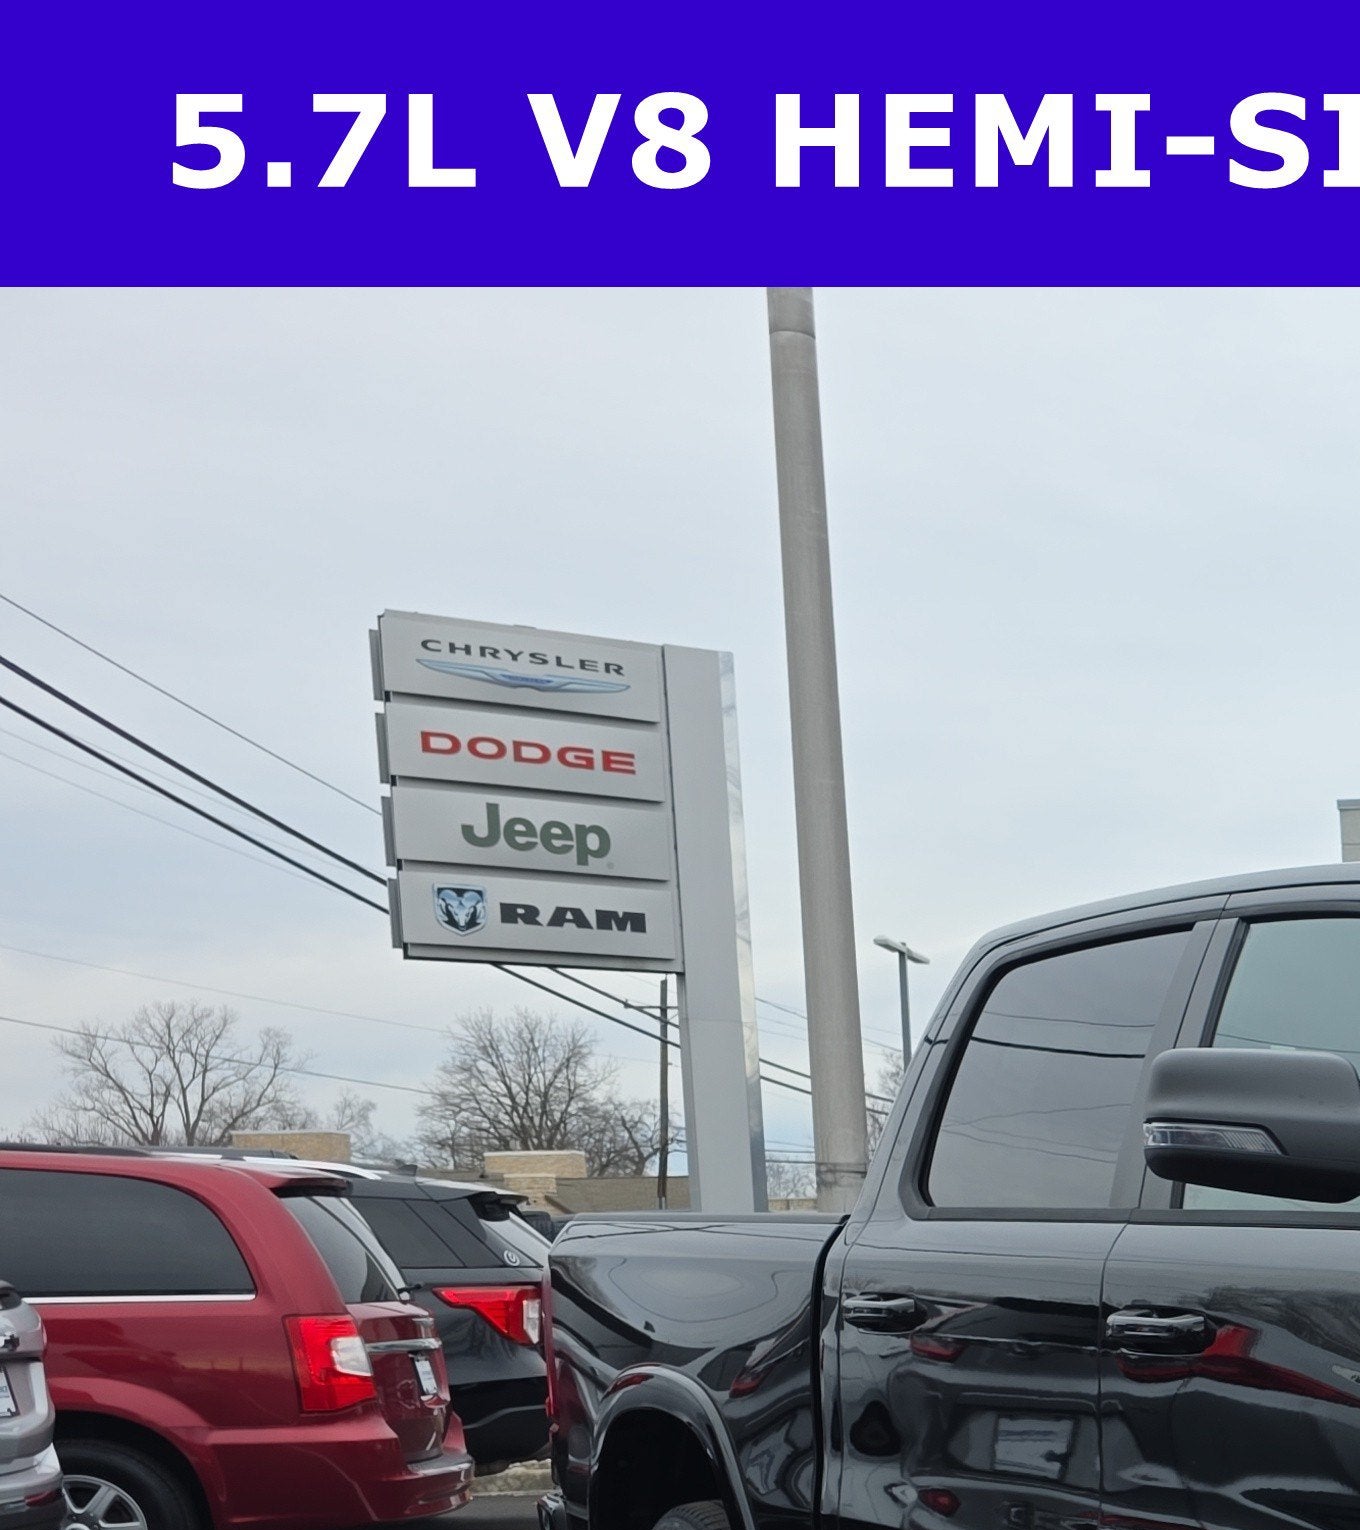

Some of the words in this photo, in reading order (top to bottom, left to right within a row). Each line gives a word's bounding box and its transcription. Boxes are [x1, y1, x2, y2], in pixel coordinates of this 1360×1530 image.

[420, 639, 626, 677] CHRYSLER
[420, 730, 637, 775] DODGE
[460, 802, 612, 867] Jeep
[499, 902, 648, 934] RAM
